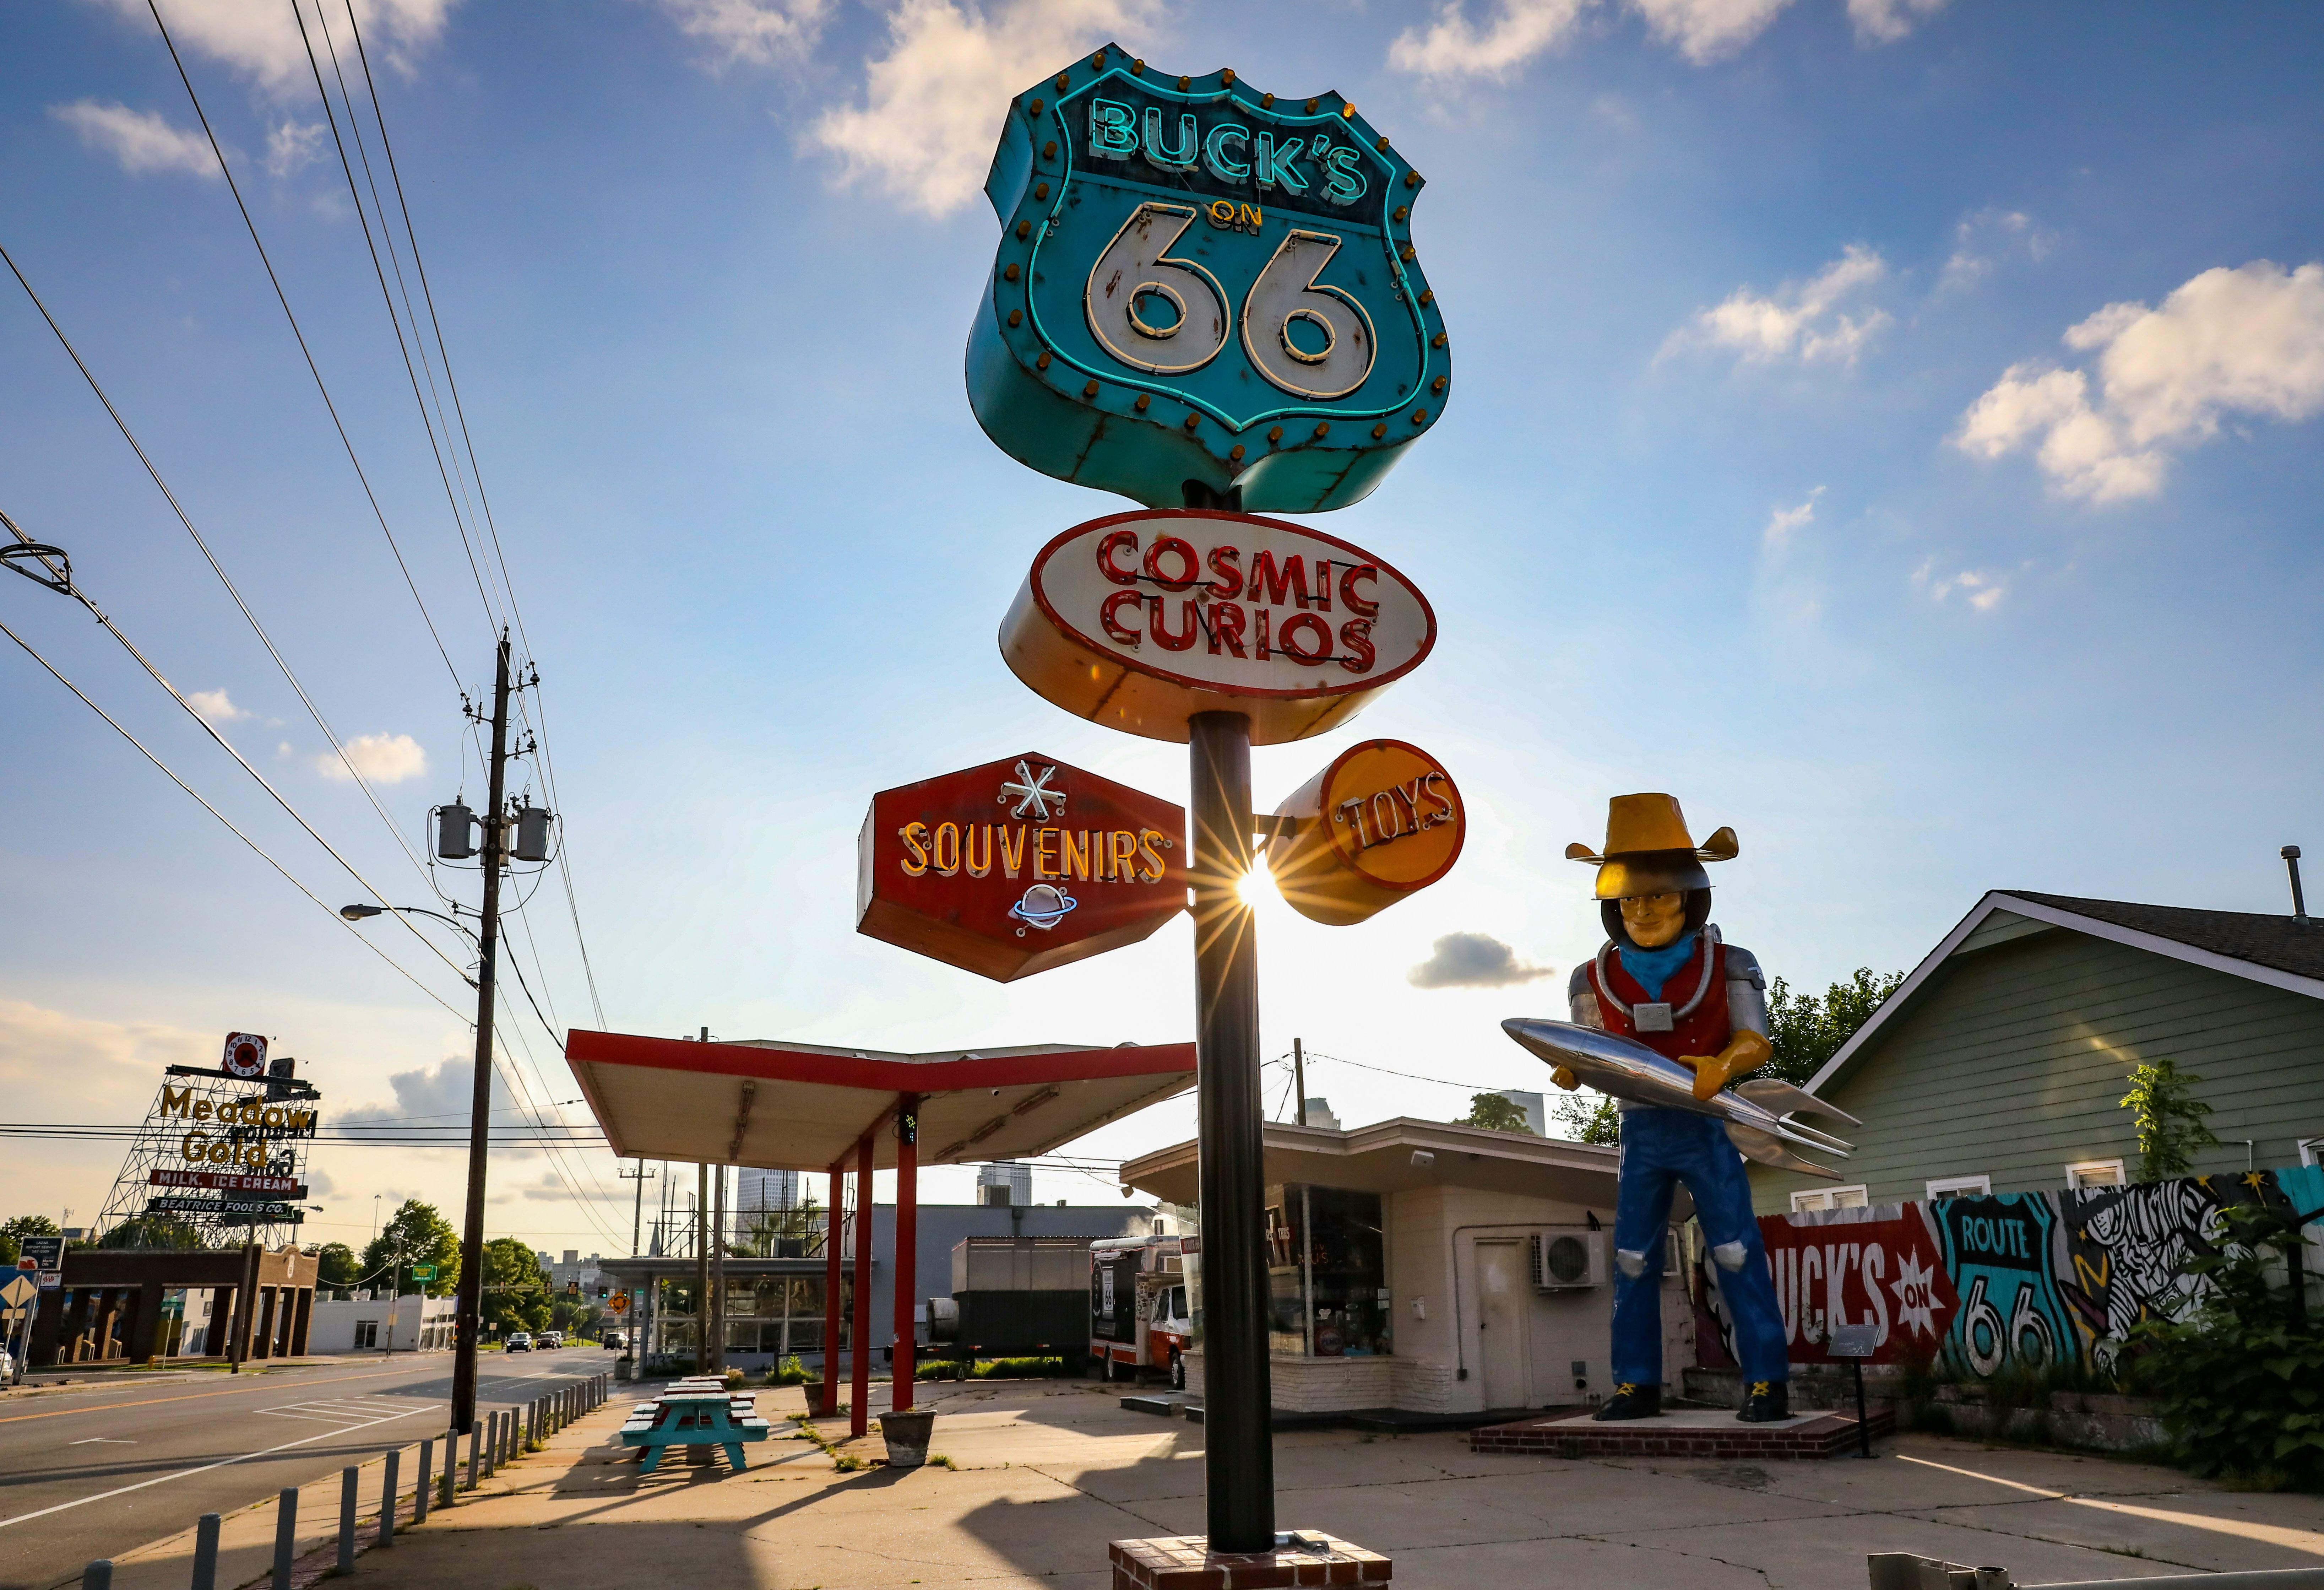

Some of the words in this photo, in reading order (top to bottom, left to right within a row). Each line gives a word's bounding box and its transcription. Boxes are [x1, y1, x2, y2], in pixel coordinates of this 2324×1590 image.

[1089, 98, 1367, 206] BUCK'S
[1205, 200, 1263, 237] ON
[1085, 201, 1378, 399] 66
[1096, 530, 1379, 618] COSMIC
[1099, 589, 1378, 674] CURIOS
[1335, 770, 1454, 855] TOYS
[898, 820, 1173, 884] SOUVENIRS
[161, 1085, 310, 1129] Meadow
[182, 1131, 268, 1167] Gold
[159, 1199, 223, 1211] BEATRICE
[266, 1204, 284, 1213] CO.
[214, 1175, 237, 1188] ICE
[243, 1177, 292, 1191] CREAM
[1962, 1215, 2031, 1258] ROUTE
[1105, 1289, 1112, 1305] 66
[1765, 1243, 1889, 1347] UCK'S
[1904, 1283, 1930, 1309] ON
[1965, 1279, 2053, 1377] 66
